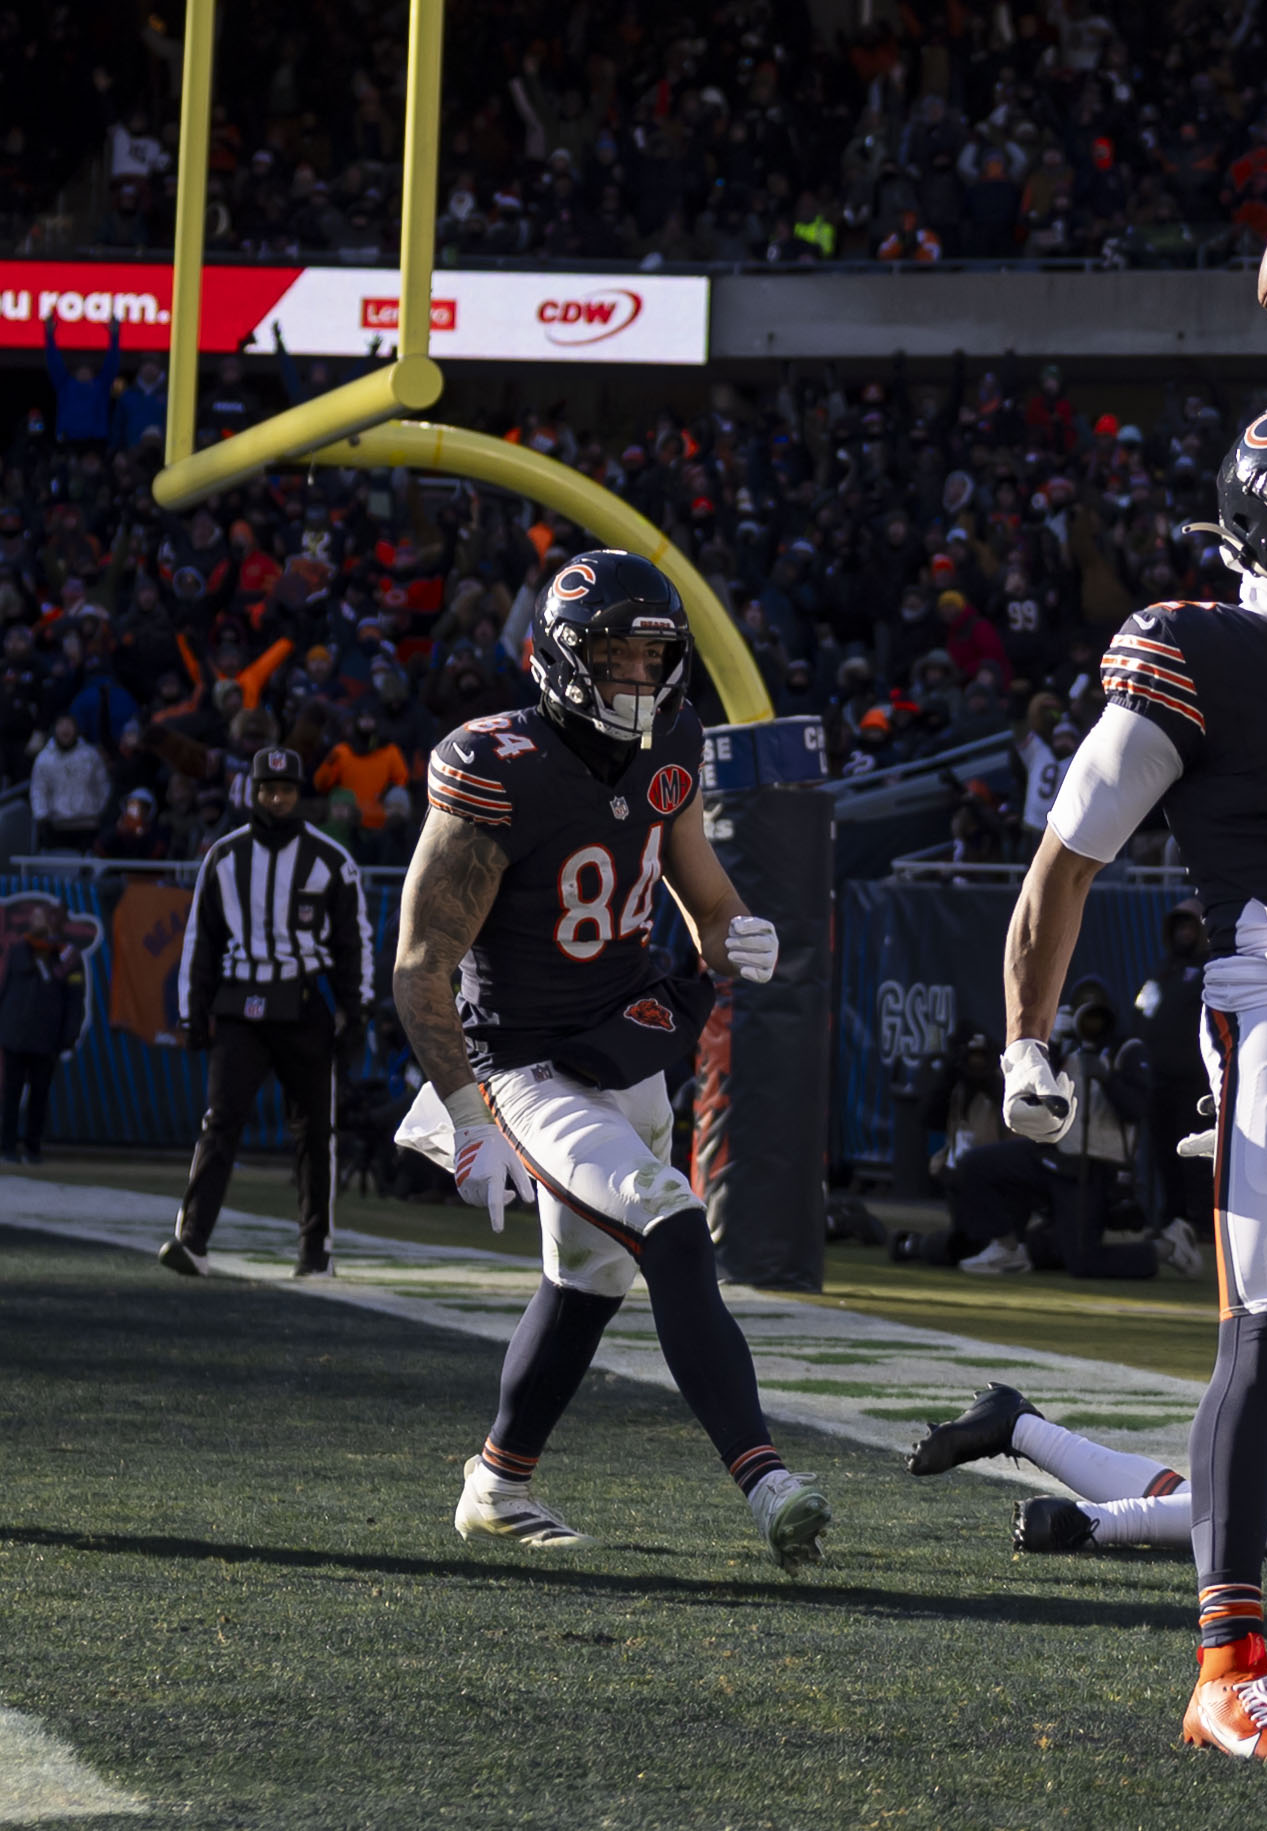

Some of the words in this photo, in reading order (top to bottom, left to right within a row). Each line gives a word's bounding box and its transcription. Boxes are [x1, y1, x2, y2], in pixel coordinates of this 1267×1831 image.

[0, 290, 30, 321] u
[38, 290, 171, 325] roam.
[537, 301, 618, 325] CDW
[554, 820, 664, 963] 84
